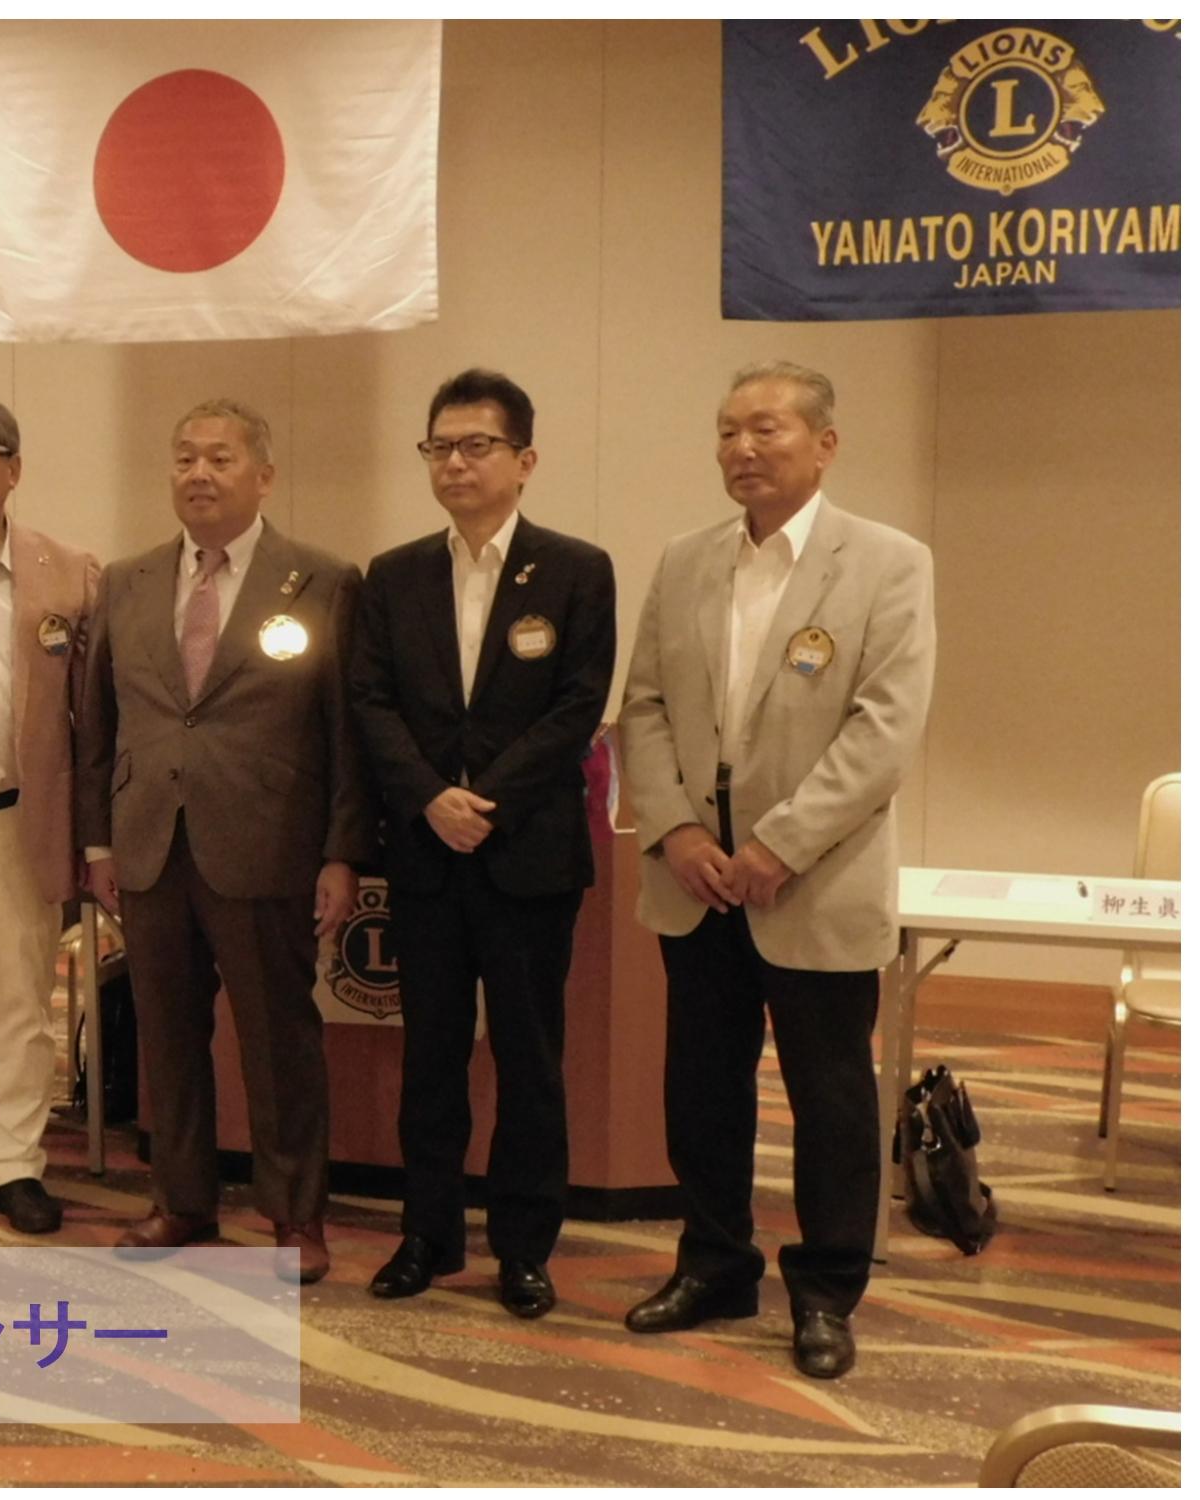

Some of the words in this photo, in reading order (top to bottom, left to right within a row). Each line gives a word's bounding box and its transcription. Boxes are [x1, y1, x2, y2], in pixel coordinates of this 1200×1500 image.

[959, 33, 1068, 73] LIONS
[990, 79, 1036, 138] L
[957, 151, 1060, 183] INTERNATIONAL
[810, 212, 973, 267] YAMATO
[989, 204, 1181, 257] KORIYAM
[954, 260, 1057, 289] JAPAN
[364, 927, 399, 972] L
